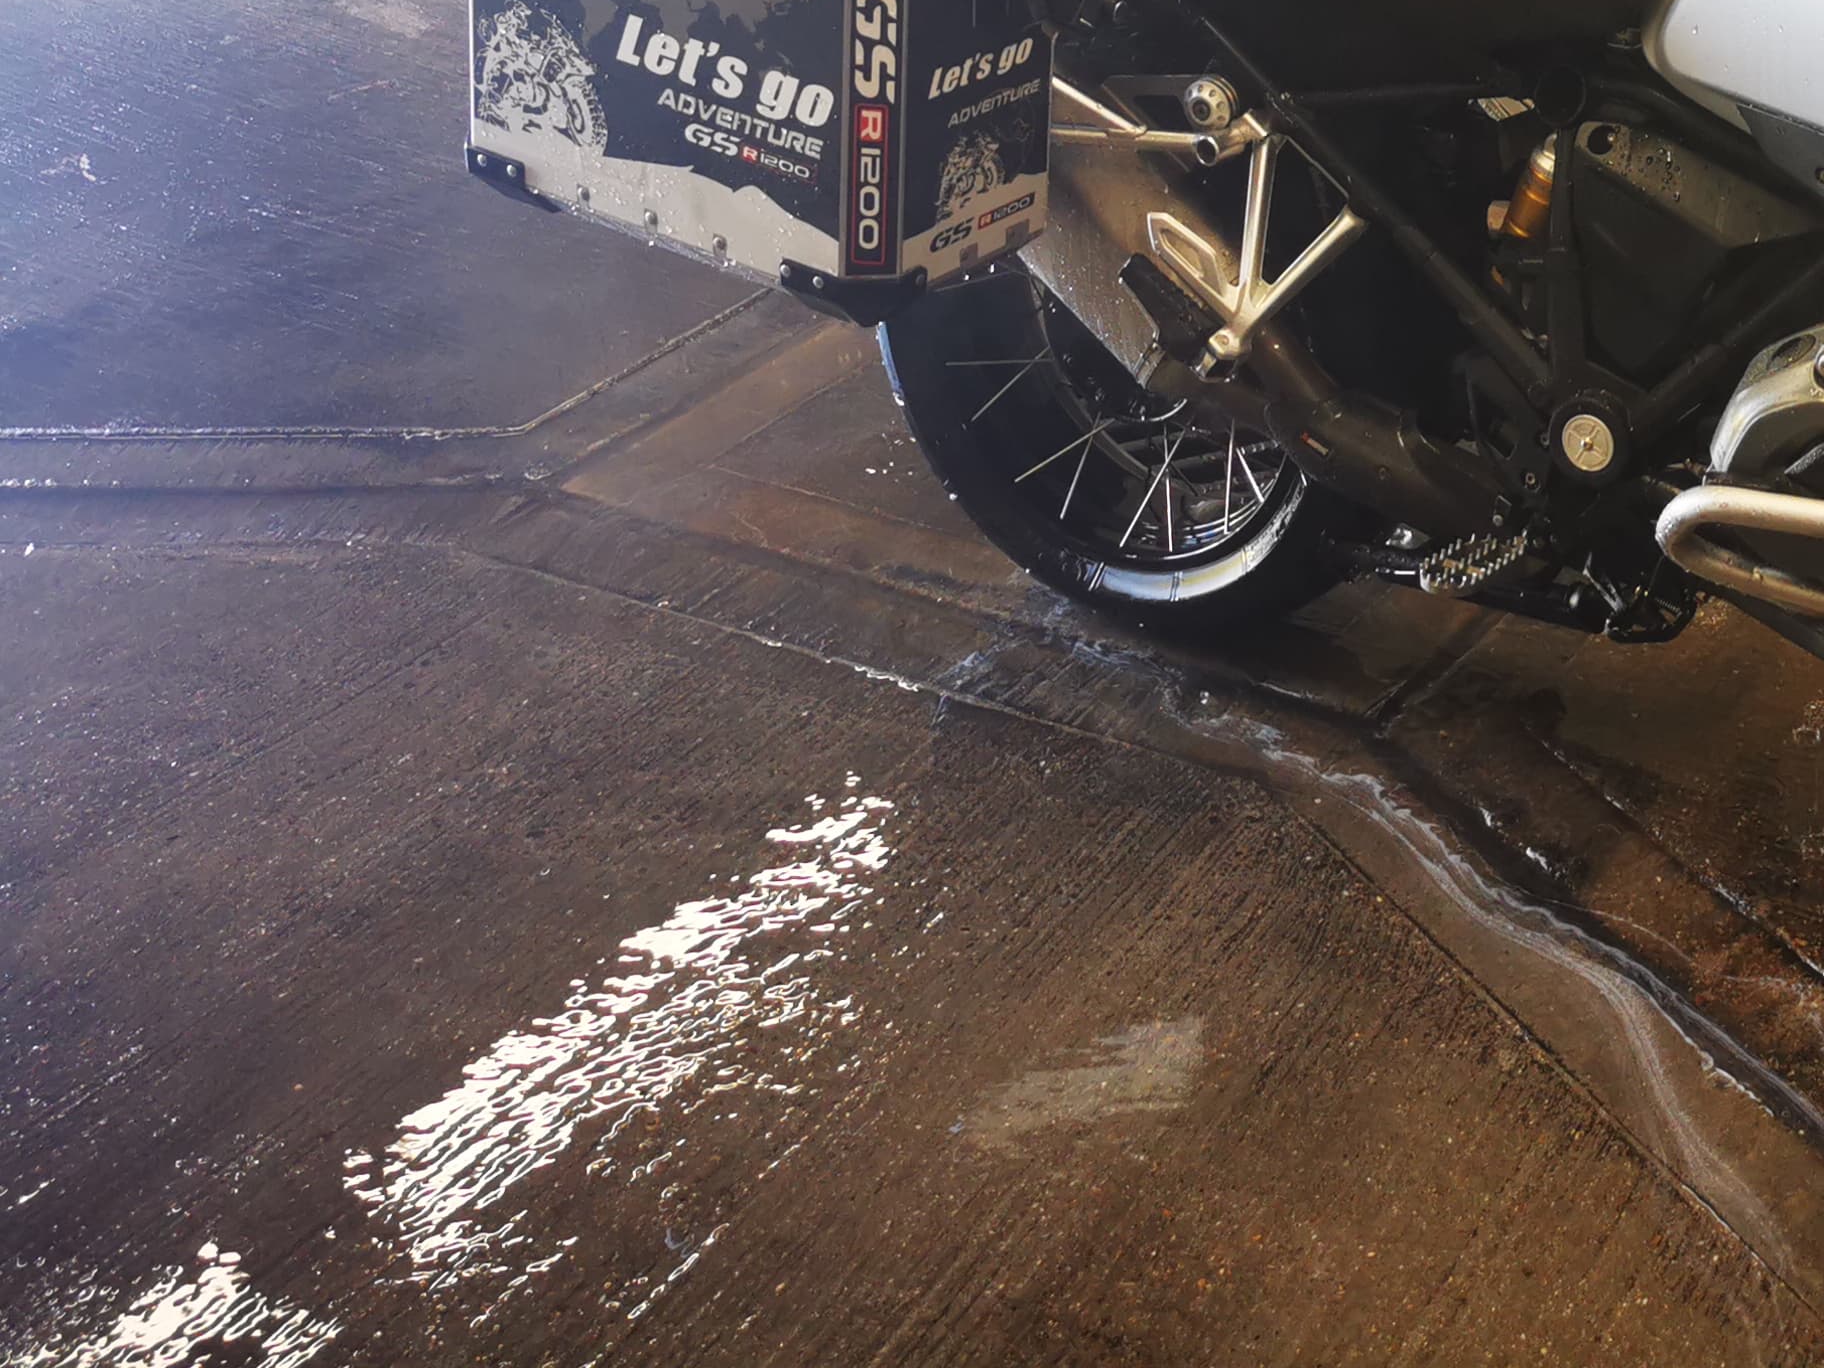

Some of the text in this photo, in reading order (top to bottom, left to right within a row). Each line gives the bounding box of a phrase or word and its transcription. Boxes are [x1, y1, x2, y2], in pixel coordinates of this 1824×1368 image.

[615, 13, 835, 127] Let's go
[927, 37, 1034, 101] Let's go
[656, 88, 825, 161] ADVENTURE
[947, 78, 1041, 129] ADVENTURE
[684, 123, 810, 179] GS R1200
[859, 109, 882, 250] R1200
[929, 217, 975, 254] GS
